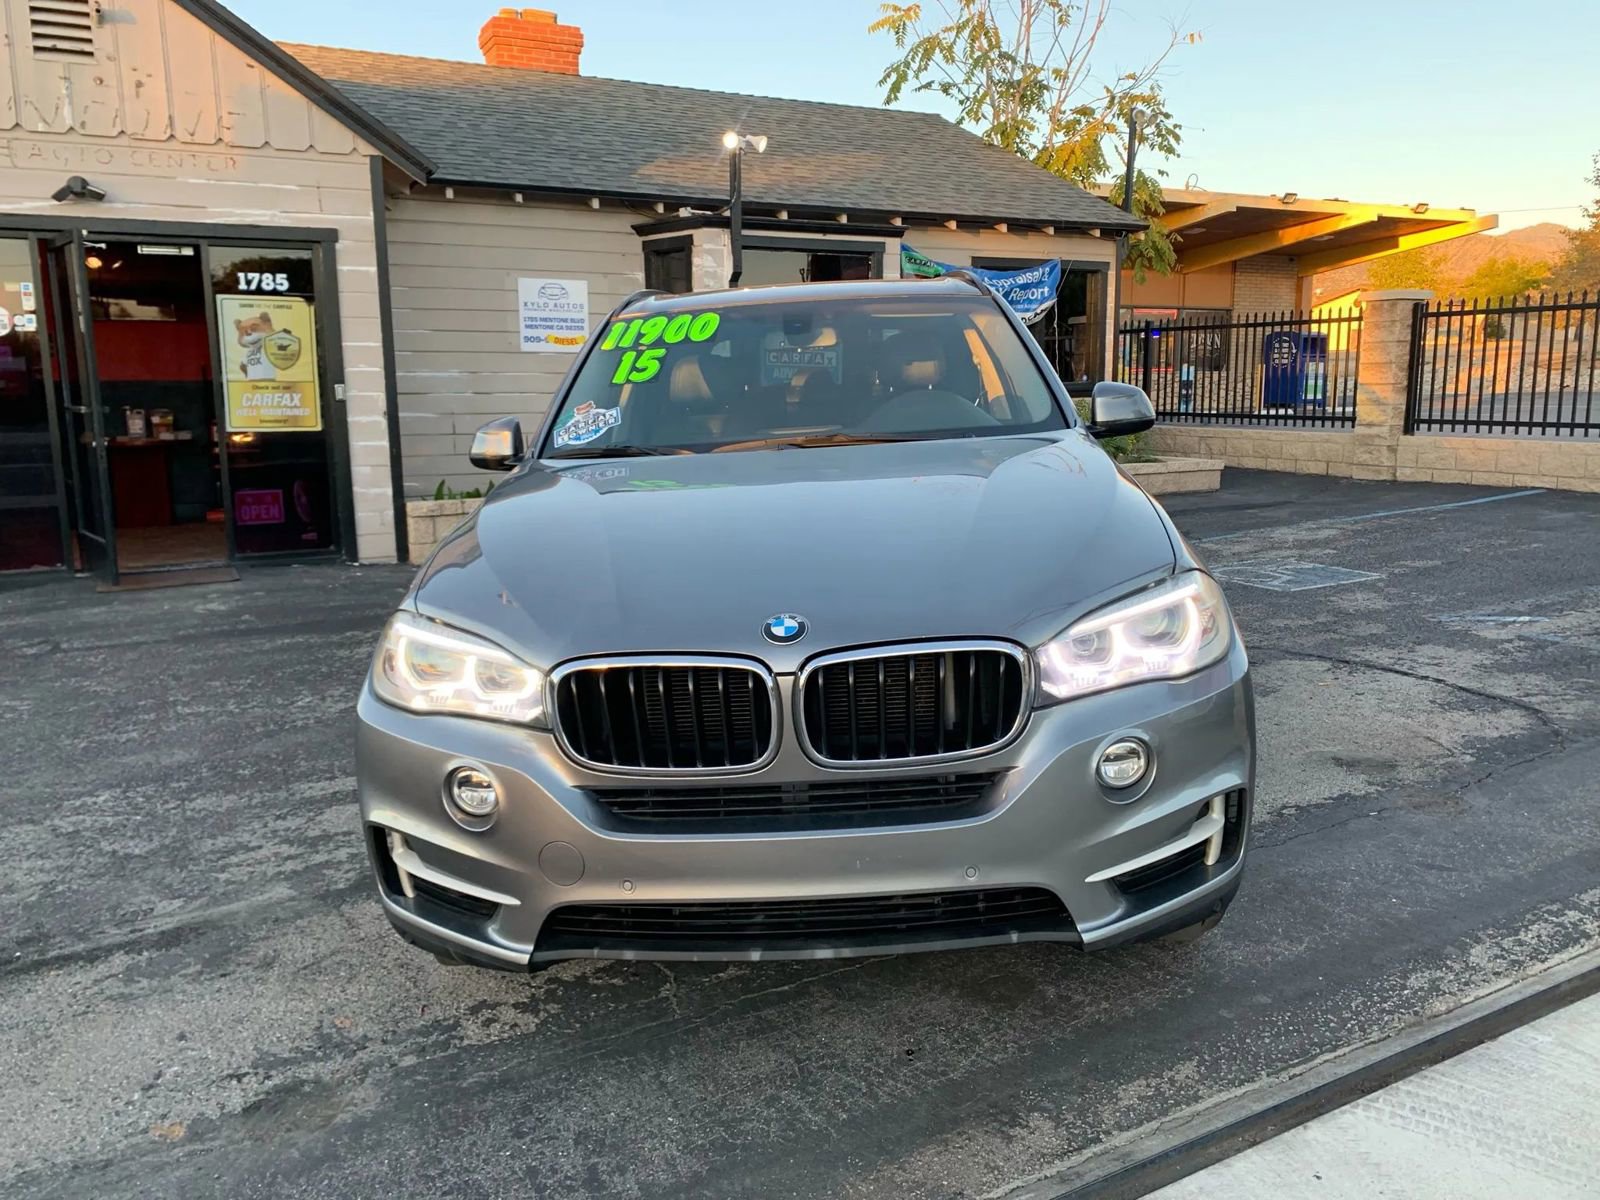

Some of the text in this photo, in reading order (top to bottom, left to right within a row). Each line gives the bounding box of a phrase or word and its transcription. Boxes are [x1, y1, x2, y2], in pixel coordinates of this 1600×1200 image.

[237, 272, 289, 291] 1785
[984, 267, 1050, 289] Appraisal &
[1008, 286, 1050, 303] Report
[523, 301, 549, 309] KYLO
[553, 302, 585, 310] AUTOS
[600, 311, 720, 351] 11900
[612, 348, 667, 384] 15
[769, 352, 837, 368] CARFAX
[242, 393, 303, 408] CARFAX
[241, 504, 279, 520] OPEN
